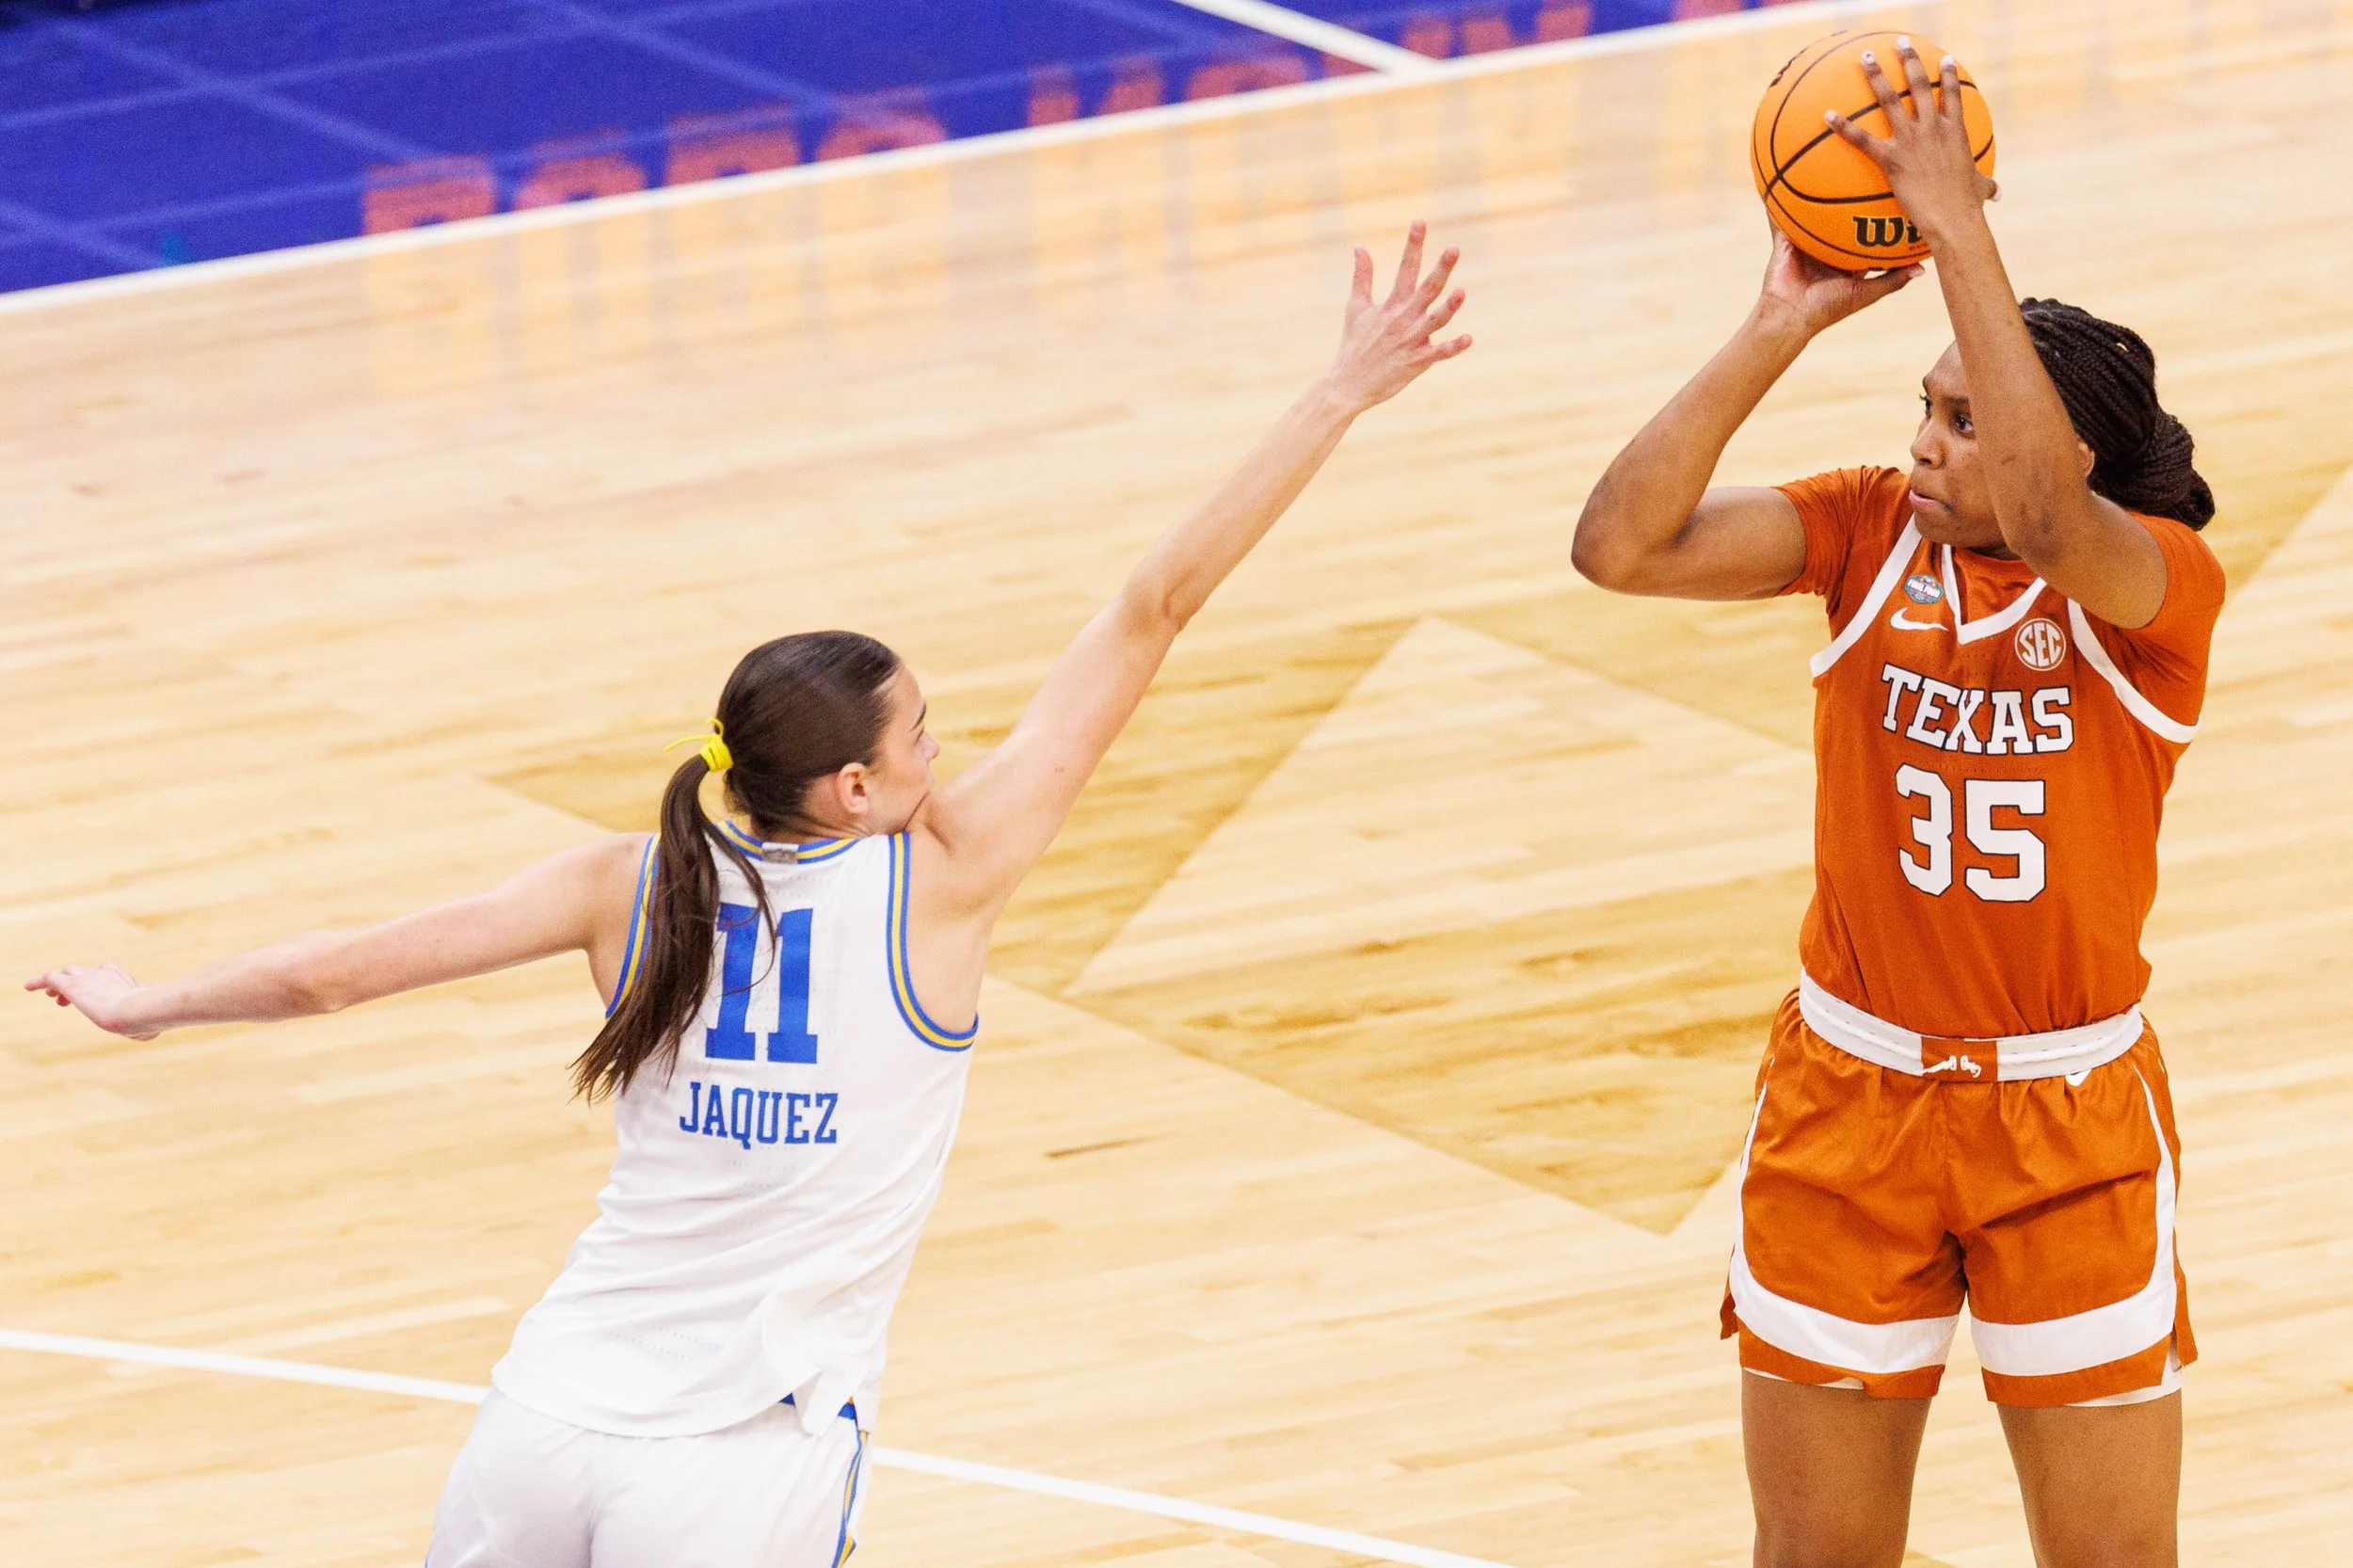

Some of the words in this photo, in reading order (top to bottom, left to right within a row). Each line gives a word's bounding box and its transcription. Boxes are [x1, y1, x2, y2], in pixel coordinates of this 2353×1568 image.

[2019, 622, 2061, 666] SEC
[1881, 662, 2074, 755] TEXAS
[1895, 761, 2047, 903] 35
[705, 902, 818, 1064] 11
[680, 1081, 839, 1149] JAQUEZ
